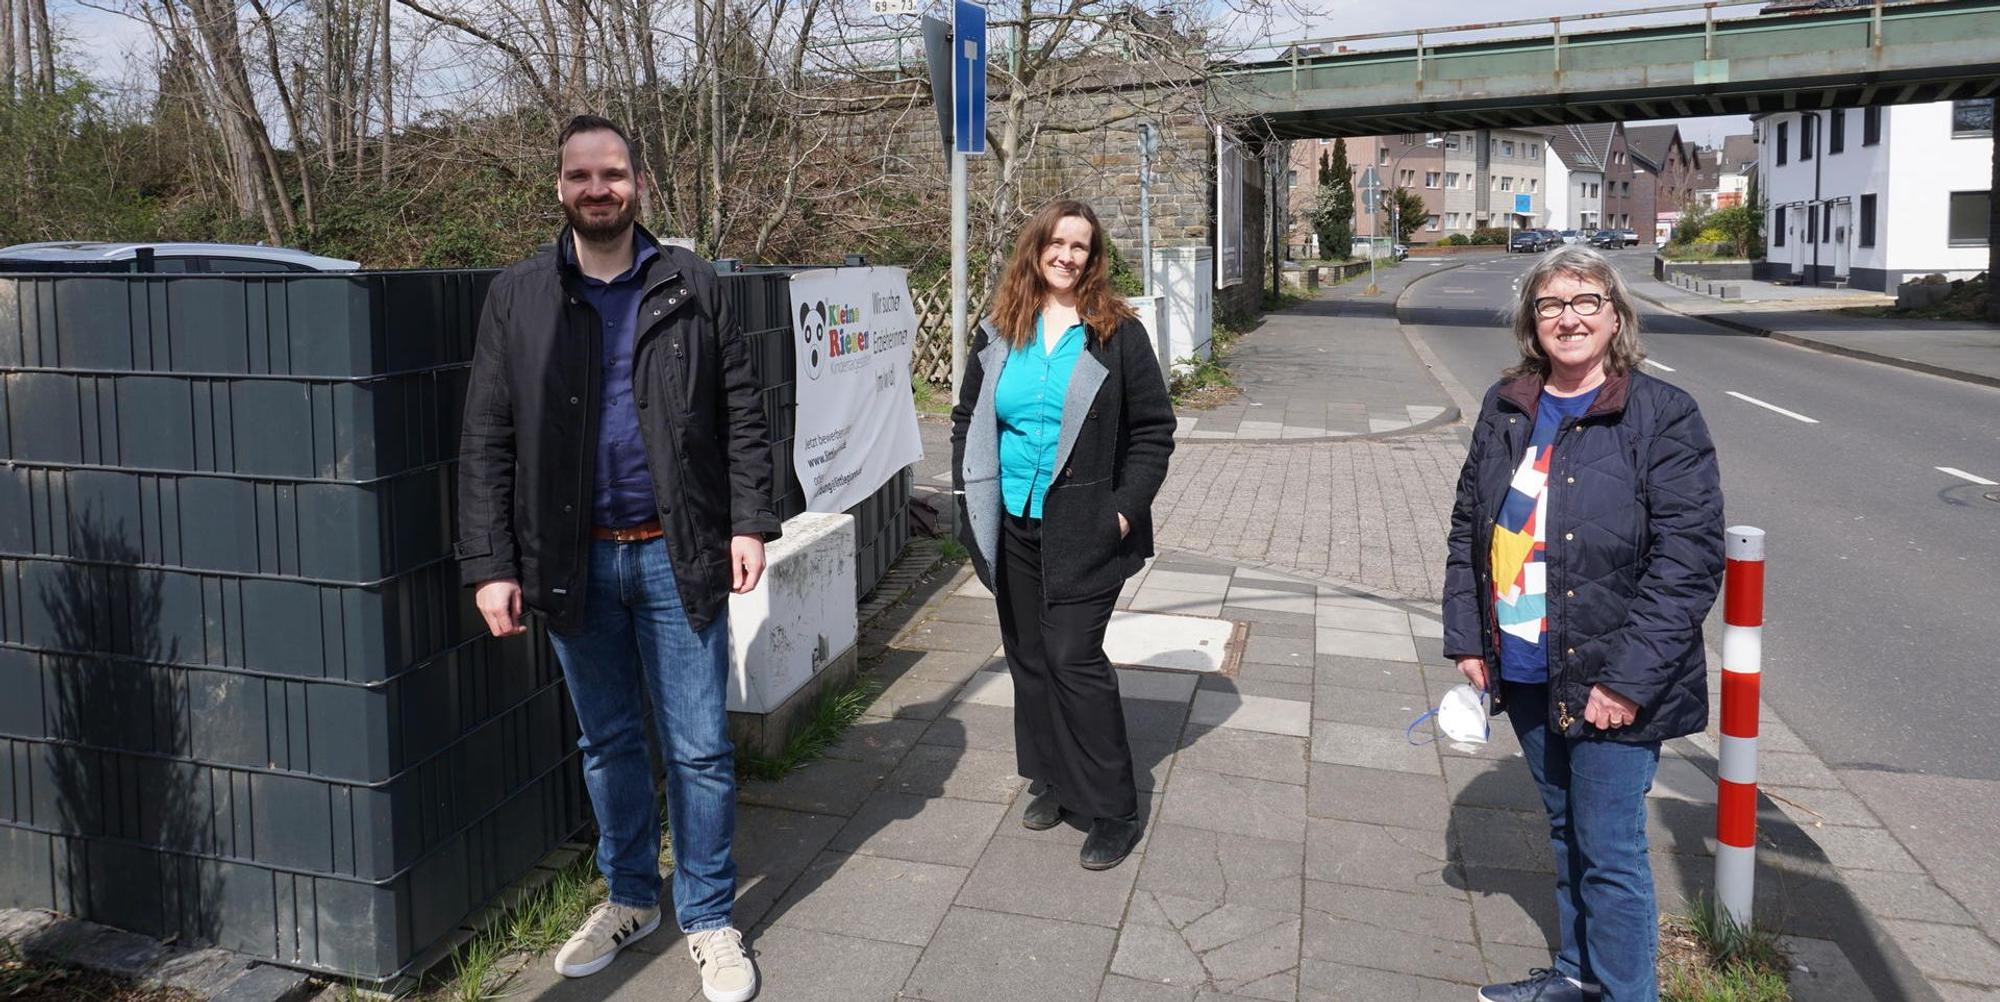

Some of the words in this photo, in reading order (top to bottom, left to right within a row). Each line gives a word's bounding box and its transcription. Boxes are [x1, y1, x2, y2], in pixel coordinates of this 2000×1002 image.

[875, 1, 887, 12] 69
[828, 303, 860, 326] Kleine
[829, 328, 869, 357] Riesen
